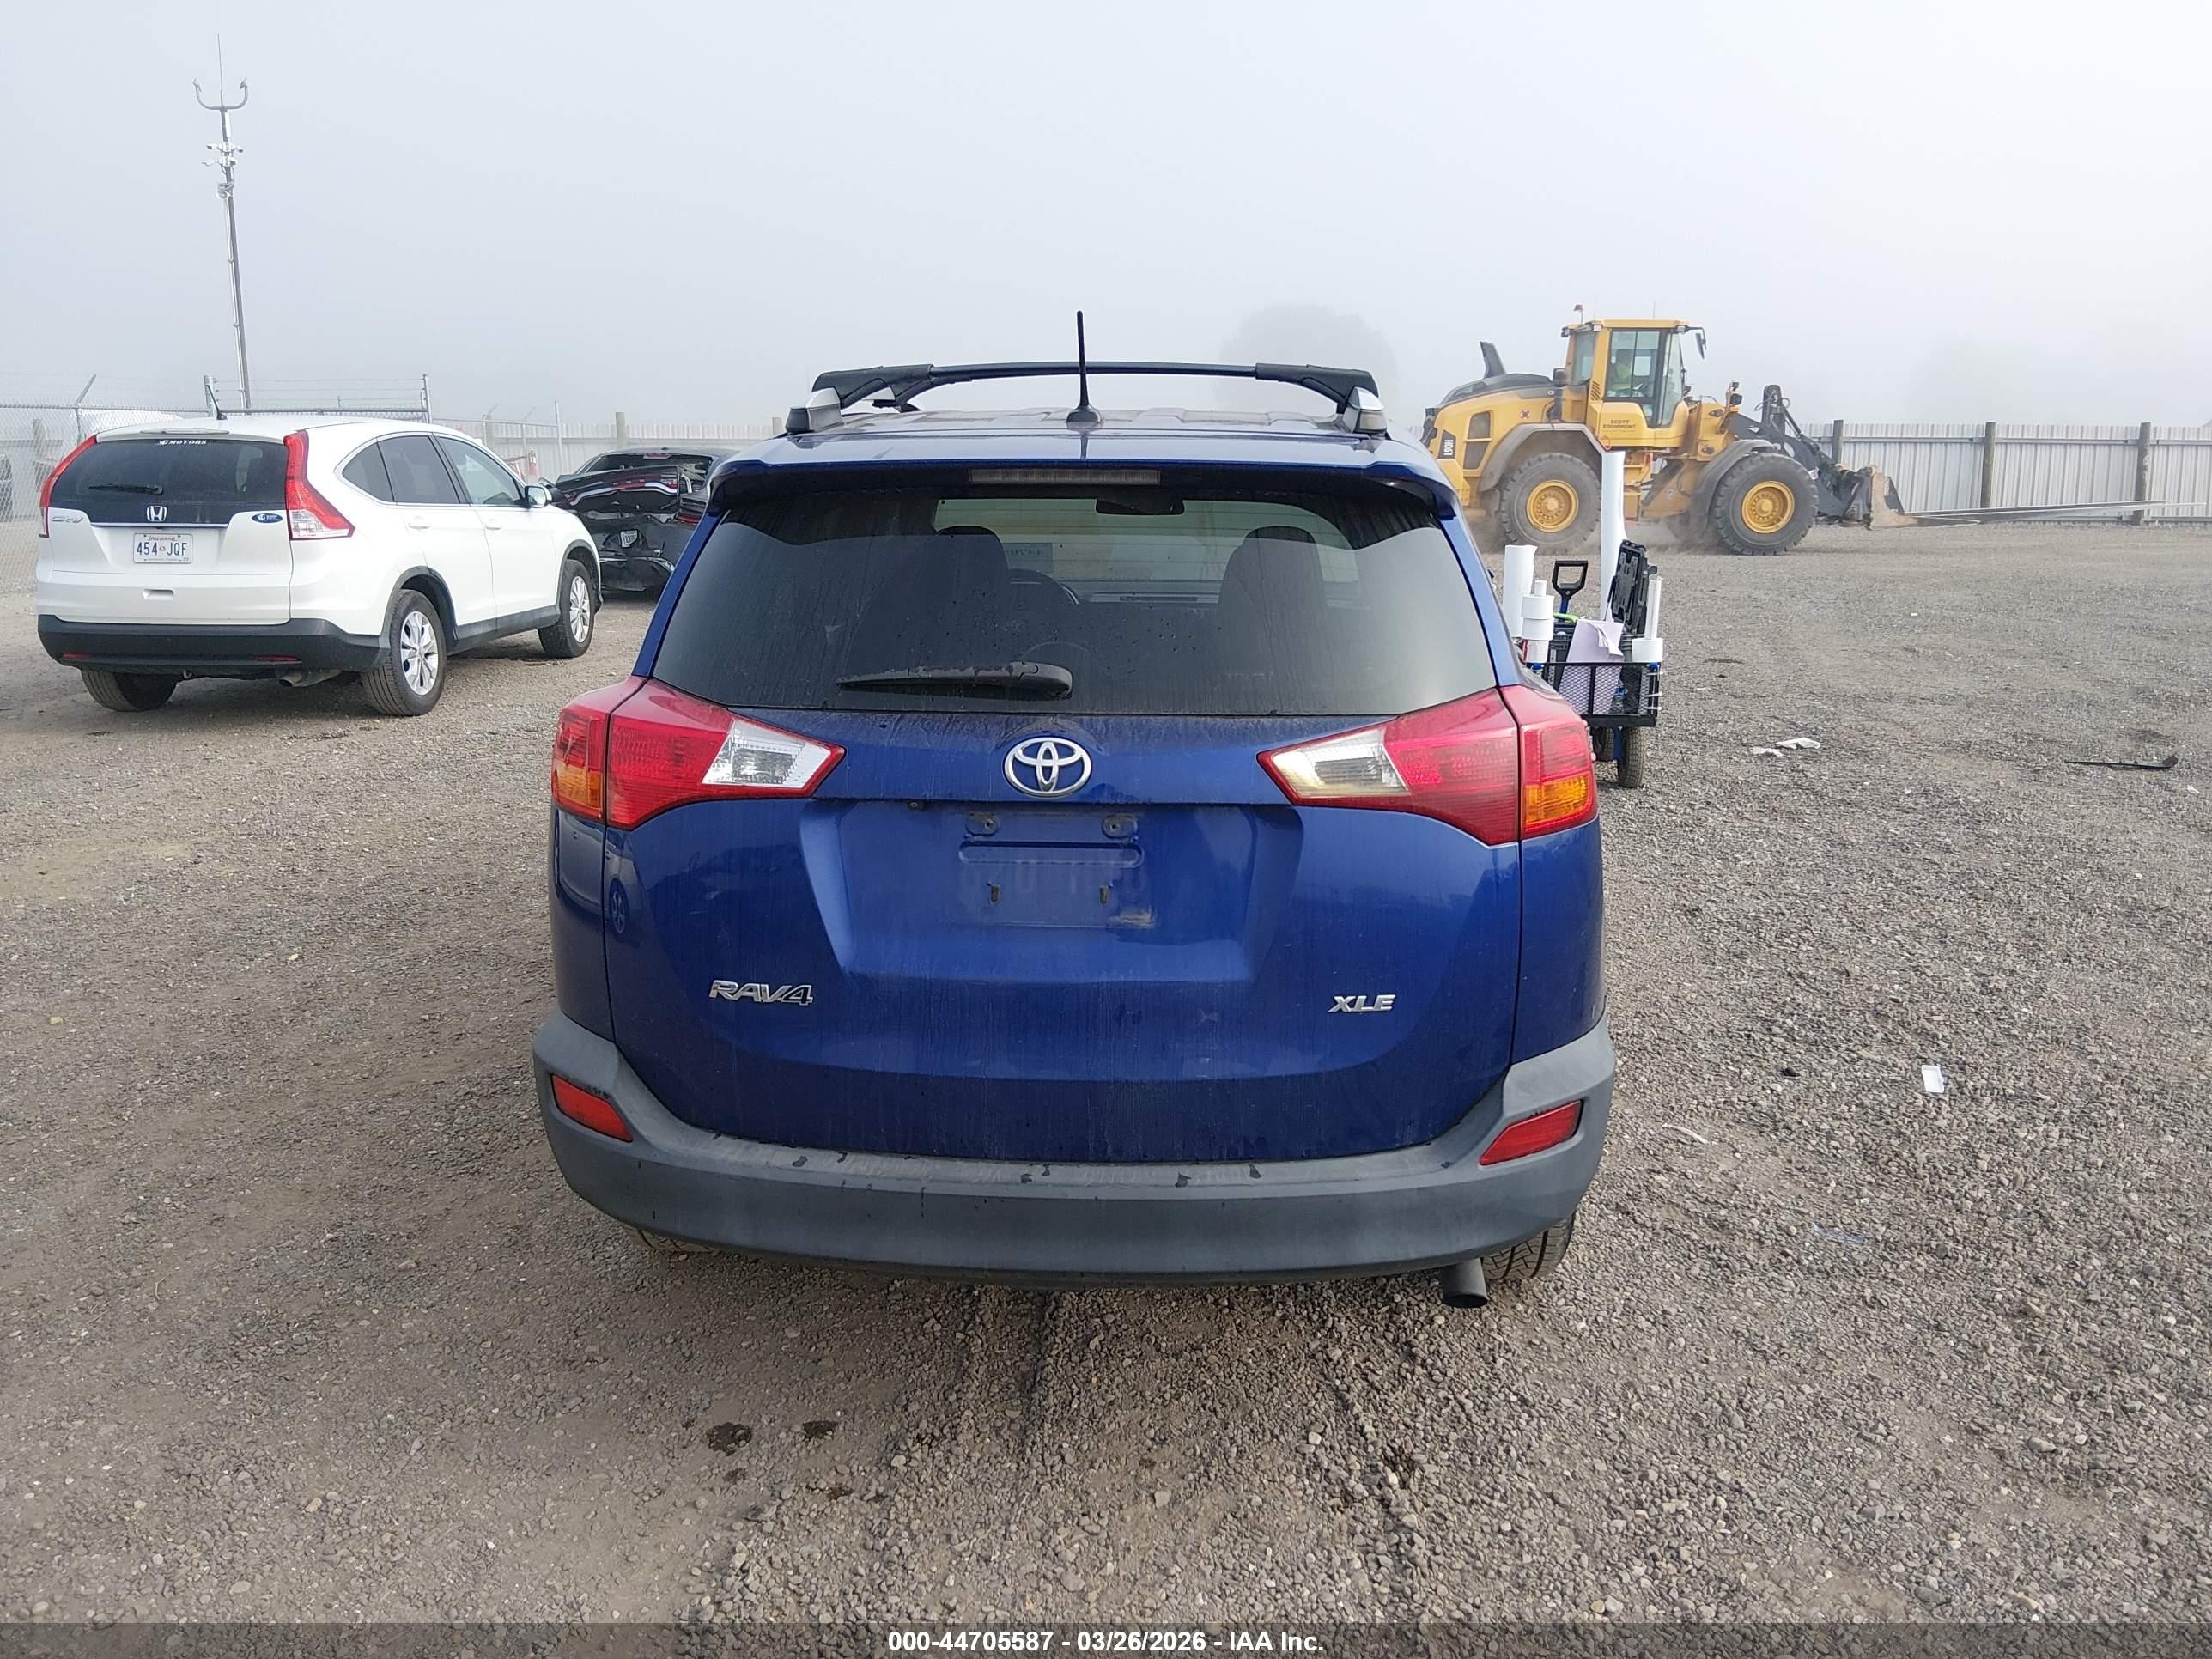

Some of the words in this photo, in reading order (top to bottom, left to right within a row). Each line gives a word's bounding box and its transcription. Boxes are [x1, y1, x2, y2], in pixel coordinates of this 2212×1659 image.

[1443, 439, 1454, 456] L90H
[137, 542, 158, 556] 454
[167, 542, 188, 556] JQF
[708, 980, 813, 1006] RAV4
[1328, 994, 1396, 1012] XLE
